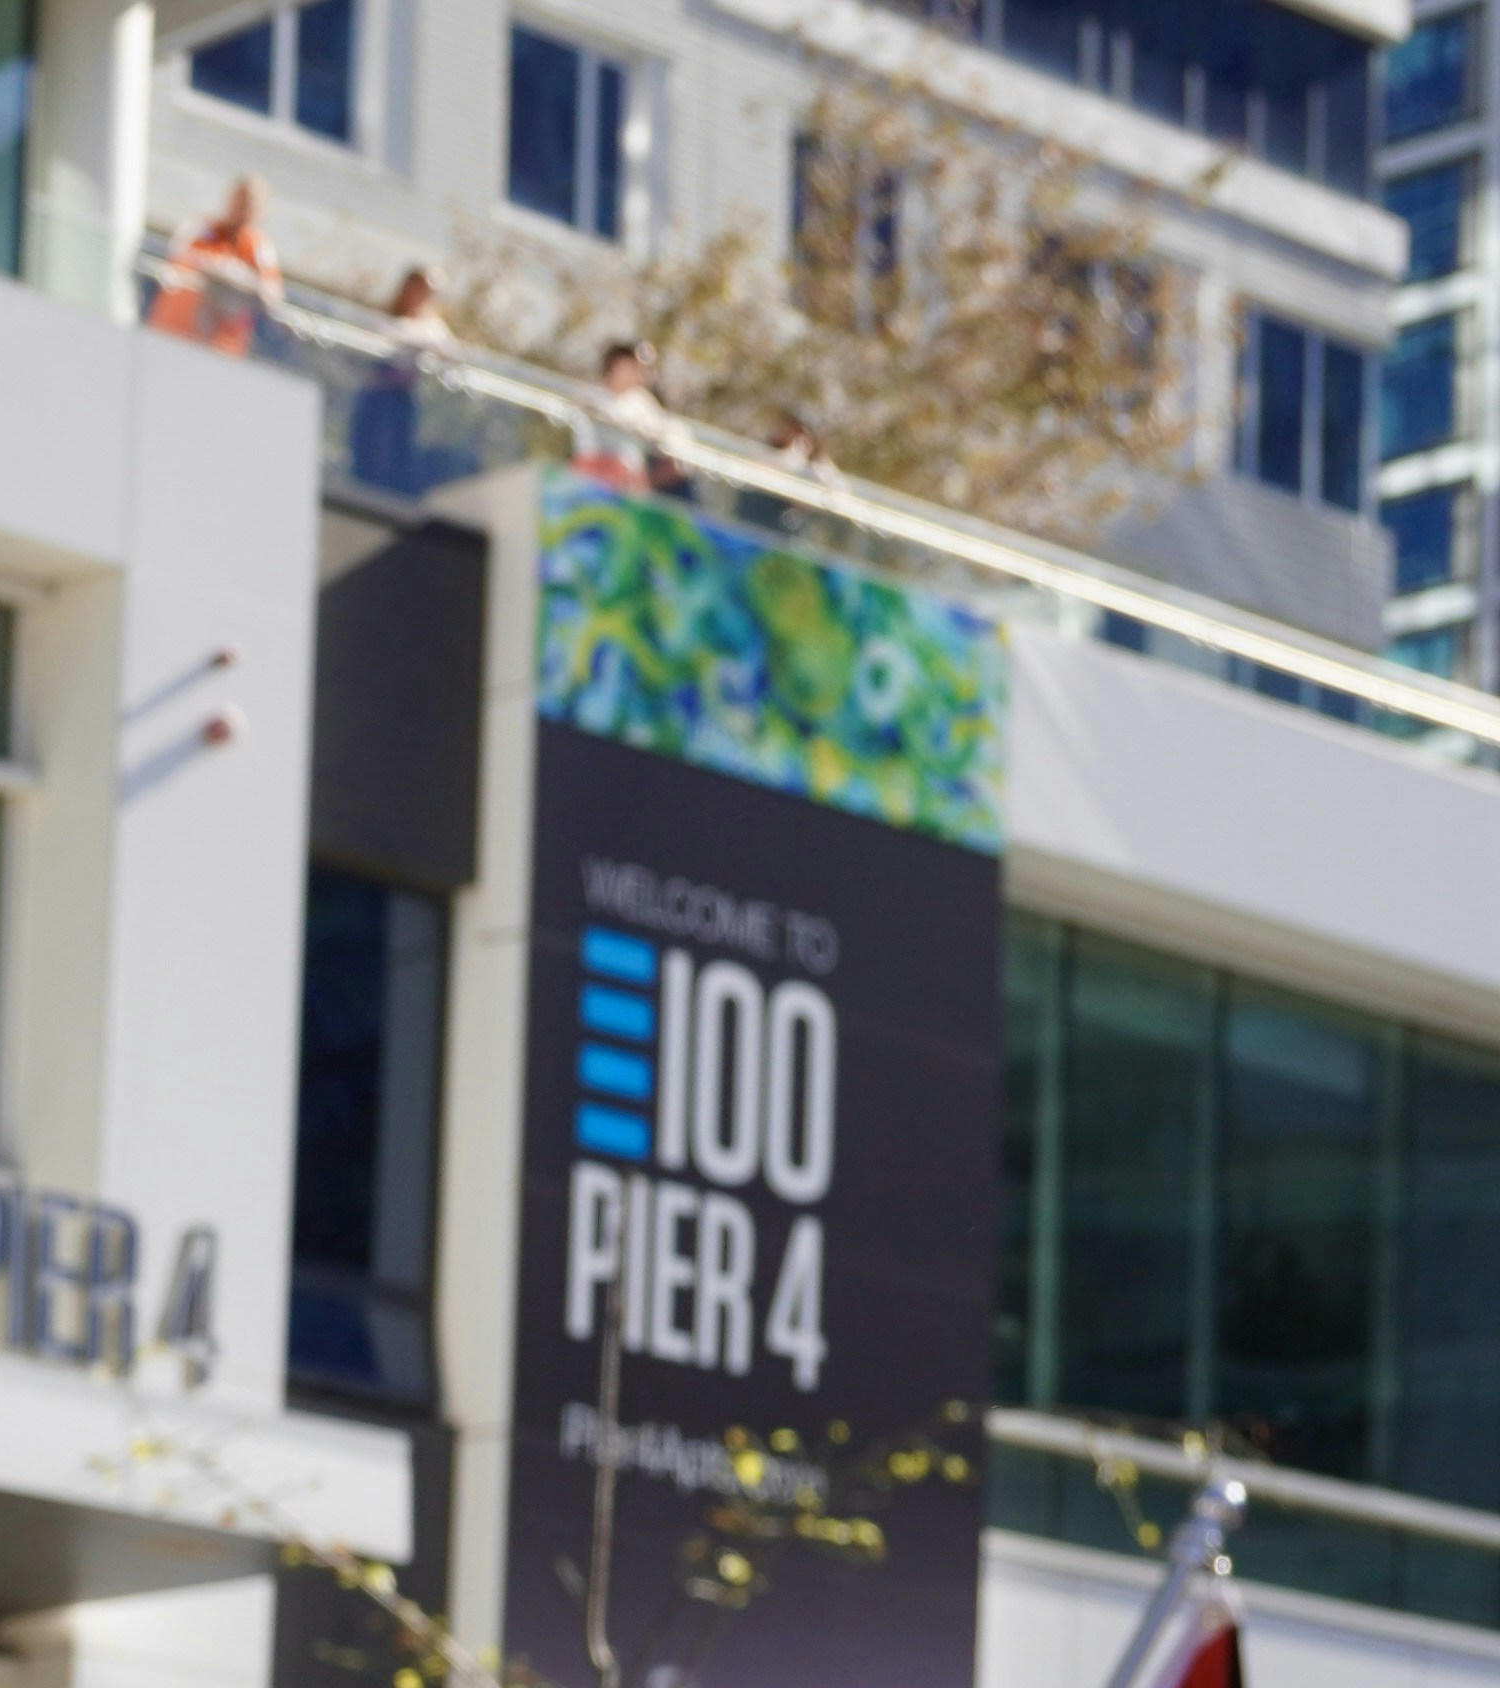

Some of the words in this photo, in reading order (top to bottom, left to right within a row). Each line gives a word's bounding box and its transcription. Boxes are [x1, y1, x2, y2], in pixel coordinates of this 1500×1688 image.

[581, 855, 769, 954] WELCOME
[784, 908, 839, 974] TO
[564, 1161, 757, 1377] PIER
[765, 1212, 827, 1394] 4
